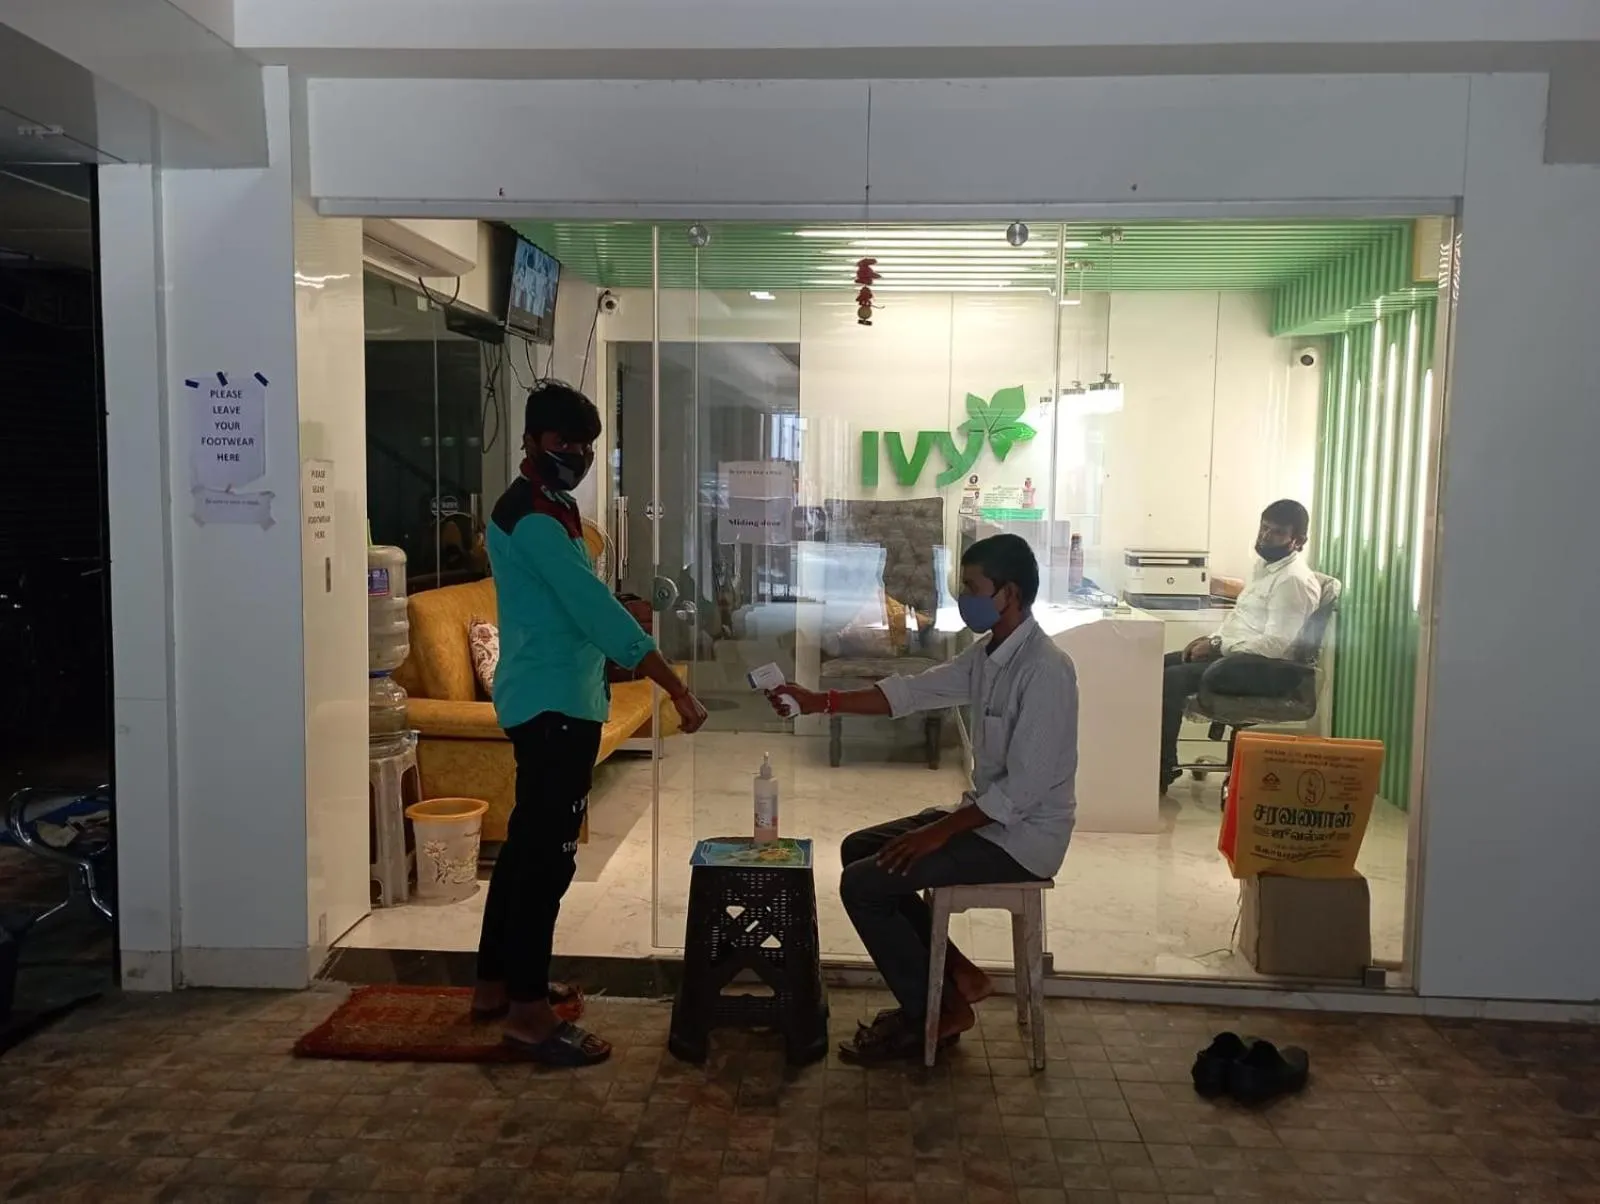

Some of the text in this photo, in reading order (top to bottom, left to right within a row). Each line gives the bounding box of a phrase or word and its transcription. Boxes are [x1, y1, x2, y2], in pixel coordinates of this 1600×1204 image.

[210, 389, 242, 399] PLEASE
[212, 405, 241, 414] LEAVE
[214, 421, 240, 430] YOUR
[201, 436, 254, 446] FOOTWEAR
[216, 453, 240, 462] HERE
